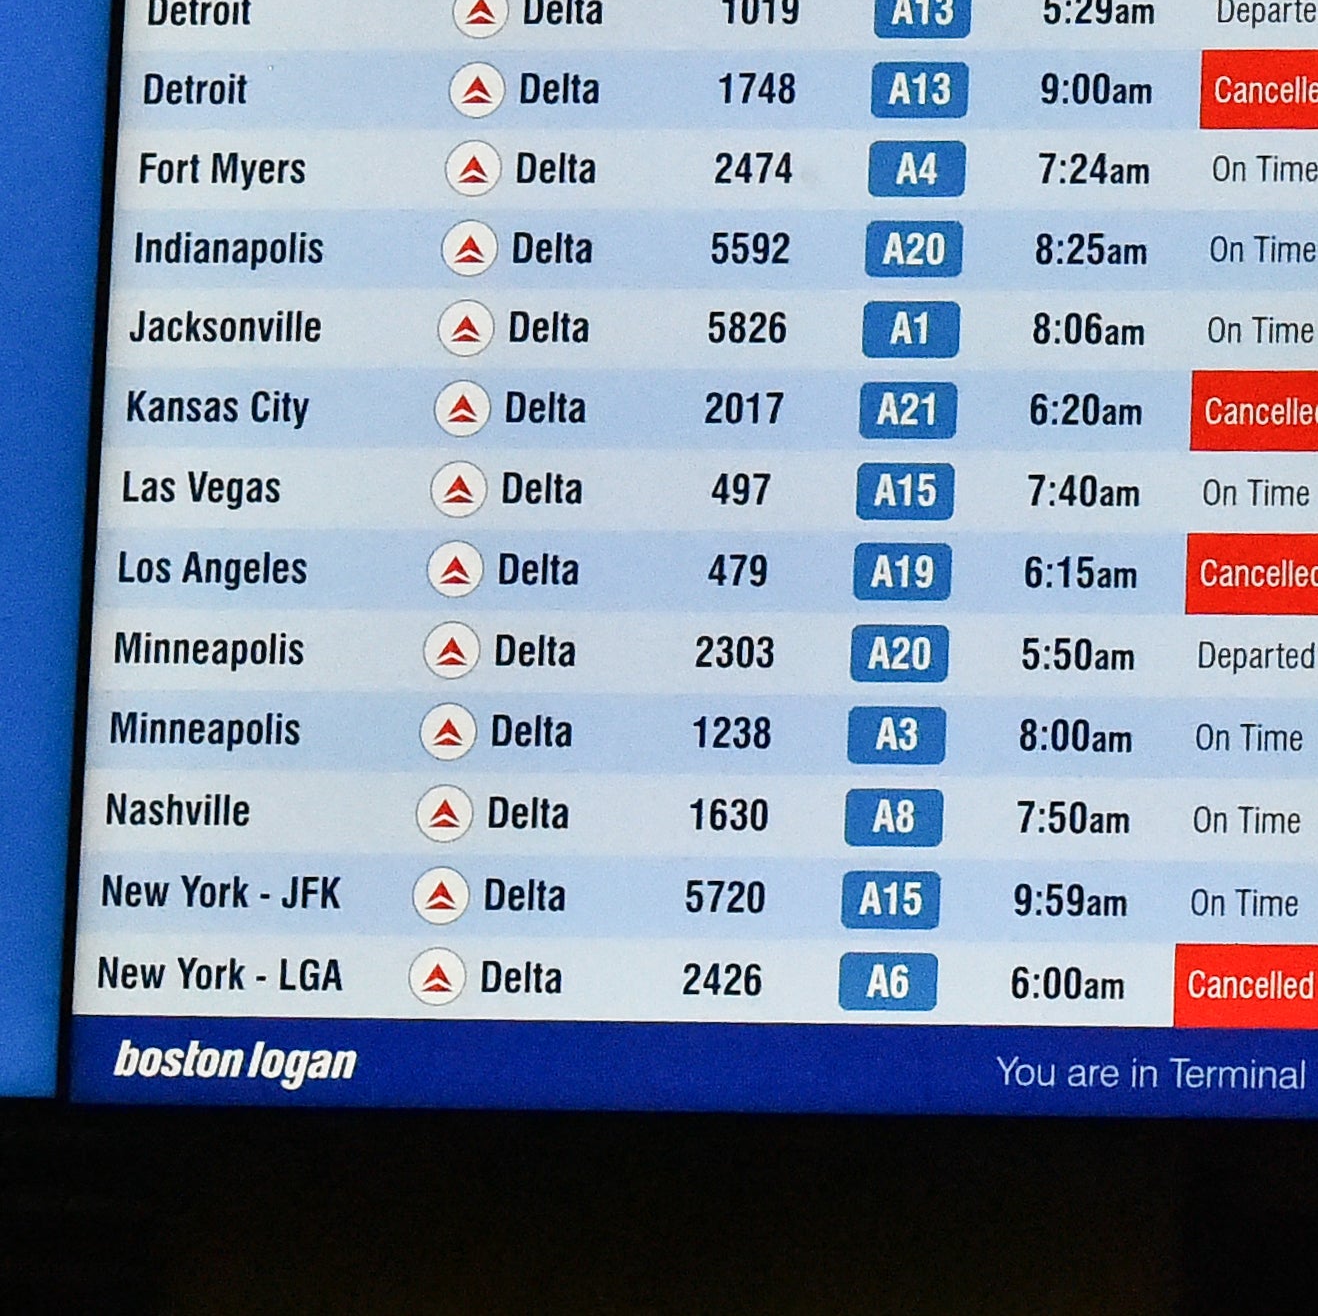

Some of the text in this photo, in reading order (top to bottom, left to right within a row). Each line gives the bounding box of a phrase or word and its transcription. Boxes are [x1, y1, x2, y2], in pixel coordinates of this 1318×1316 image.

[139, 151, 1318, 191] Fort Myers Delta 2474 A4 7:24am On Time
[126, 390, 239, 423] Kansas
[250, 390, 310, 430] City
[704, 391, 785, 425] 2017
[875, 391, 936, 426] A21
[1030, 392, 1143, 426] 6:20am
[114, 631, 1316, 675] Minneapolis Delta 2303 A20 5:50am Departed
[112, 1038, 245, 1079] boston
[246, 1040, 358, 1091] logan
[996, 1055, 1056, 1087] You
[1067, 1064, 1120, 1088] are
[1131, 1057, 1158, 1090] in
[1169, 1057, 1306, 1090] Terminal
